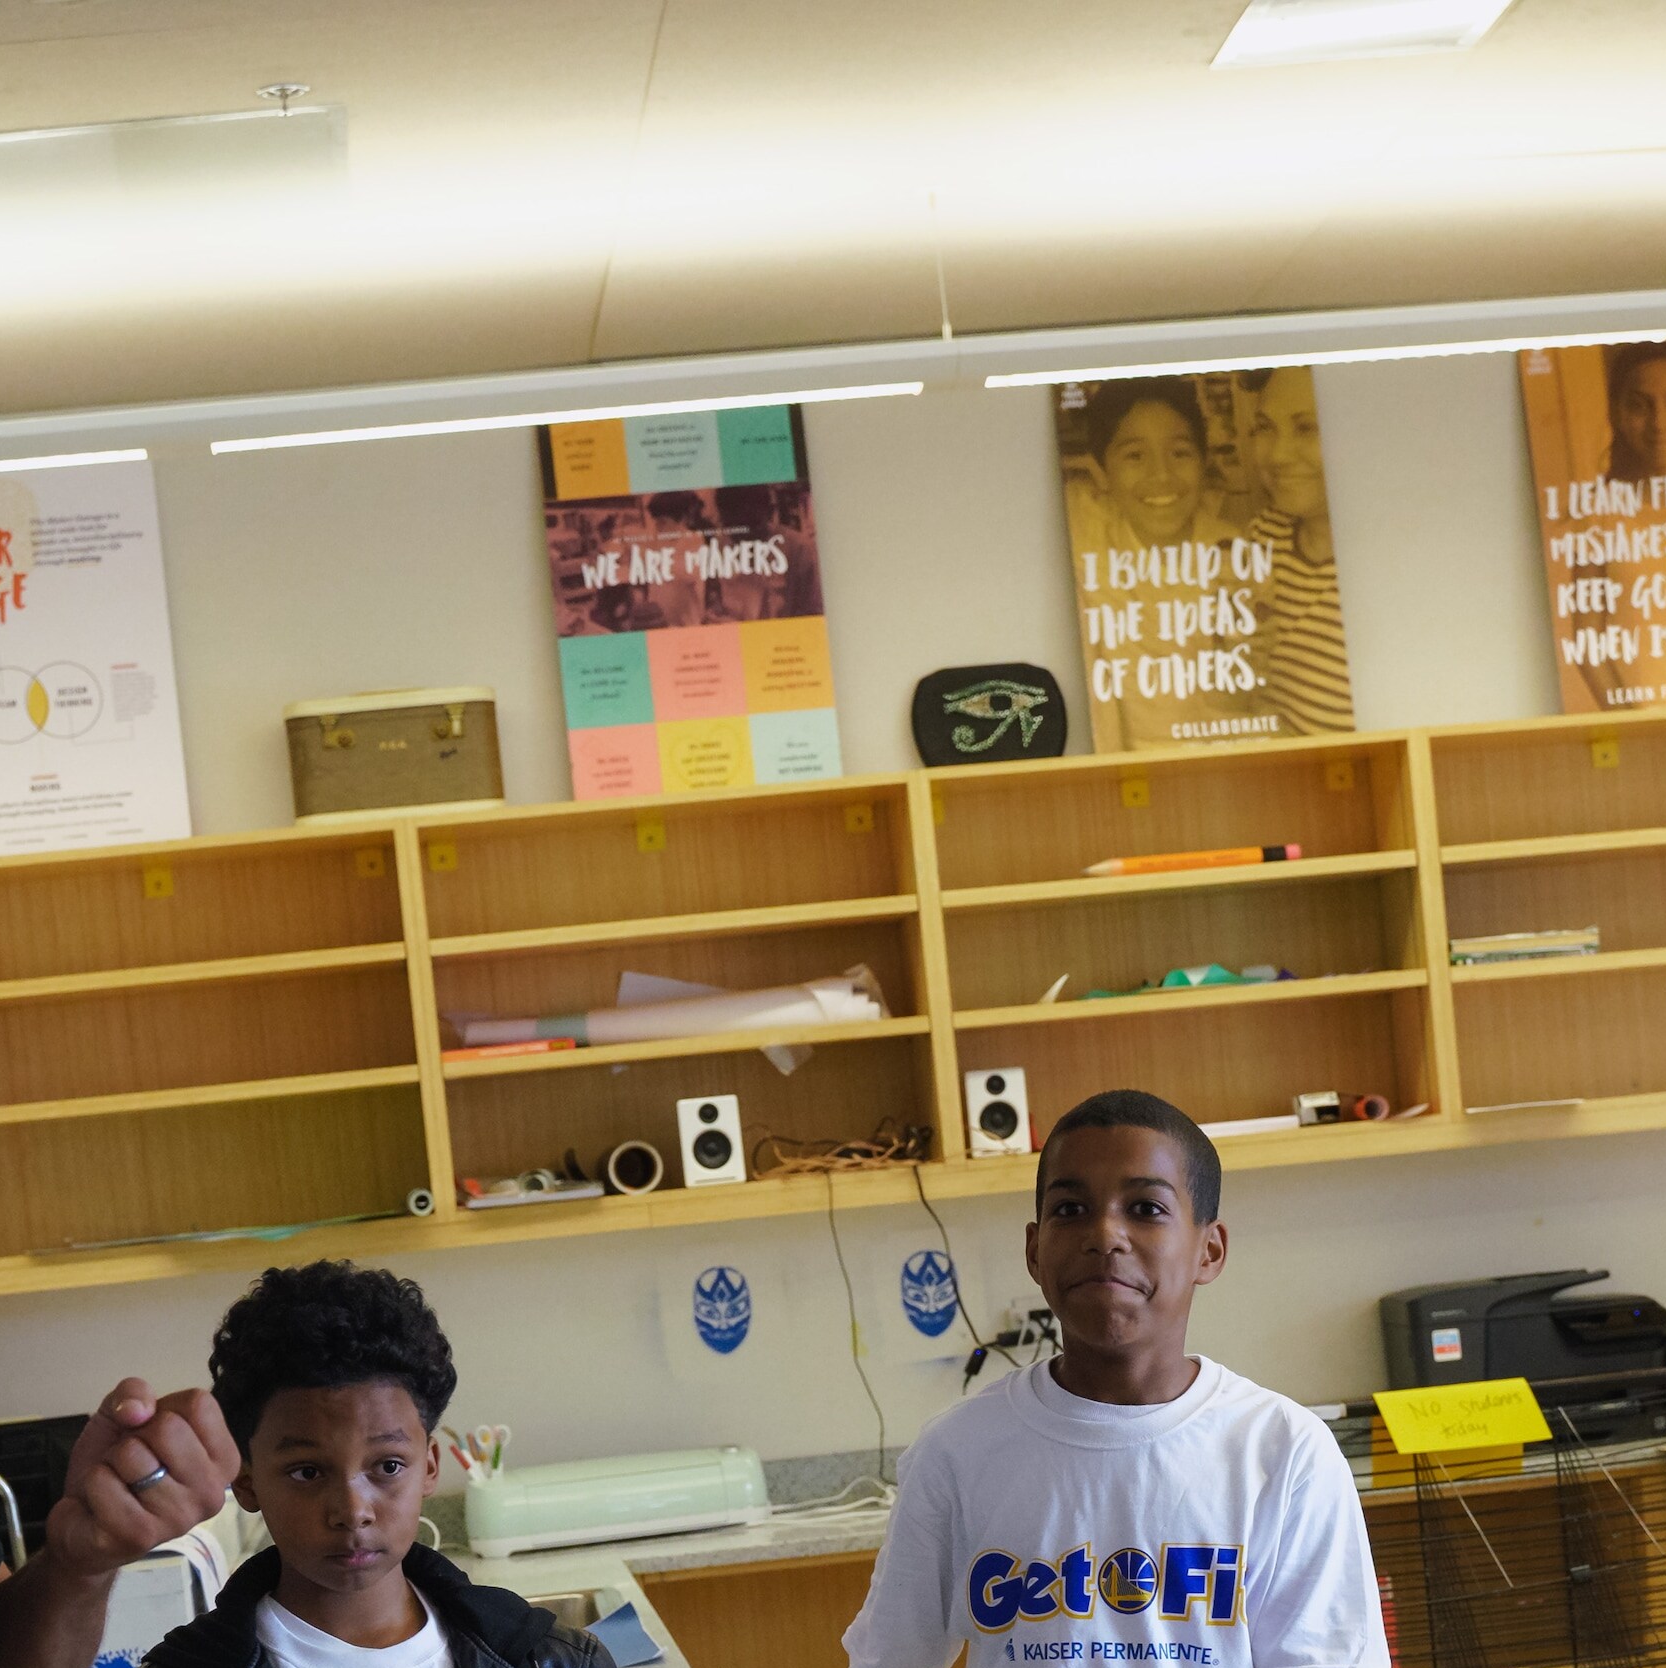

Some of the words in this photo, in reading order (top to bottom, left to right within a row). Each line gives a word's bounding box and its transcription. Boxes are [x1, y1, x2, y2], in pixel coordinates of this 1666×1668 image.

[1544, 487, 1560, 519] I
[1568, 474, 1644, 519] LEARN
[581, 552, 622, 589] WE
[629, 544, 676, 585] ARE
[685, 534, 789, 581] MAKERS
[1081, 552, 1101, 592] I
[1108, 540, 1222, 590] BUILD
[1230, 537, 1274, 583] ON
[1084, 601, 1144, 650] THE
[1156, 586, 1258, 647] IDEAS
[1557, 577, 1624, 618] KEEP
[1561, 624, 1640, 667] WHEN
[1092, 657, 1130, 702] OF
[1136, 643, 1267, 701] OTHERS.
[1606, 683, 1656, 705] LEARN
[1171, 714, 1279, 739] COLLABORATE
[967, 1541, 1097, 1634] Get
[1158, 1542, 1248, 1627] Fi
[1023, 1641, 1083, 1662] KAISER
